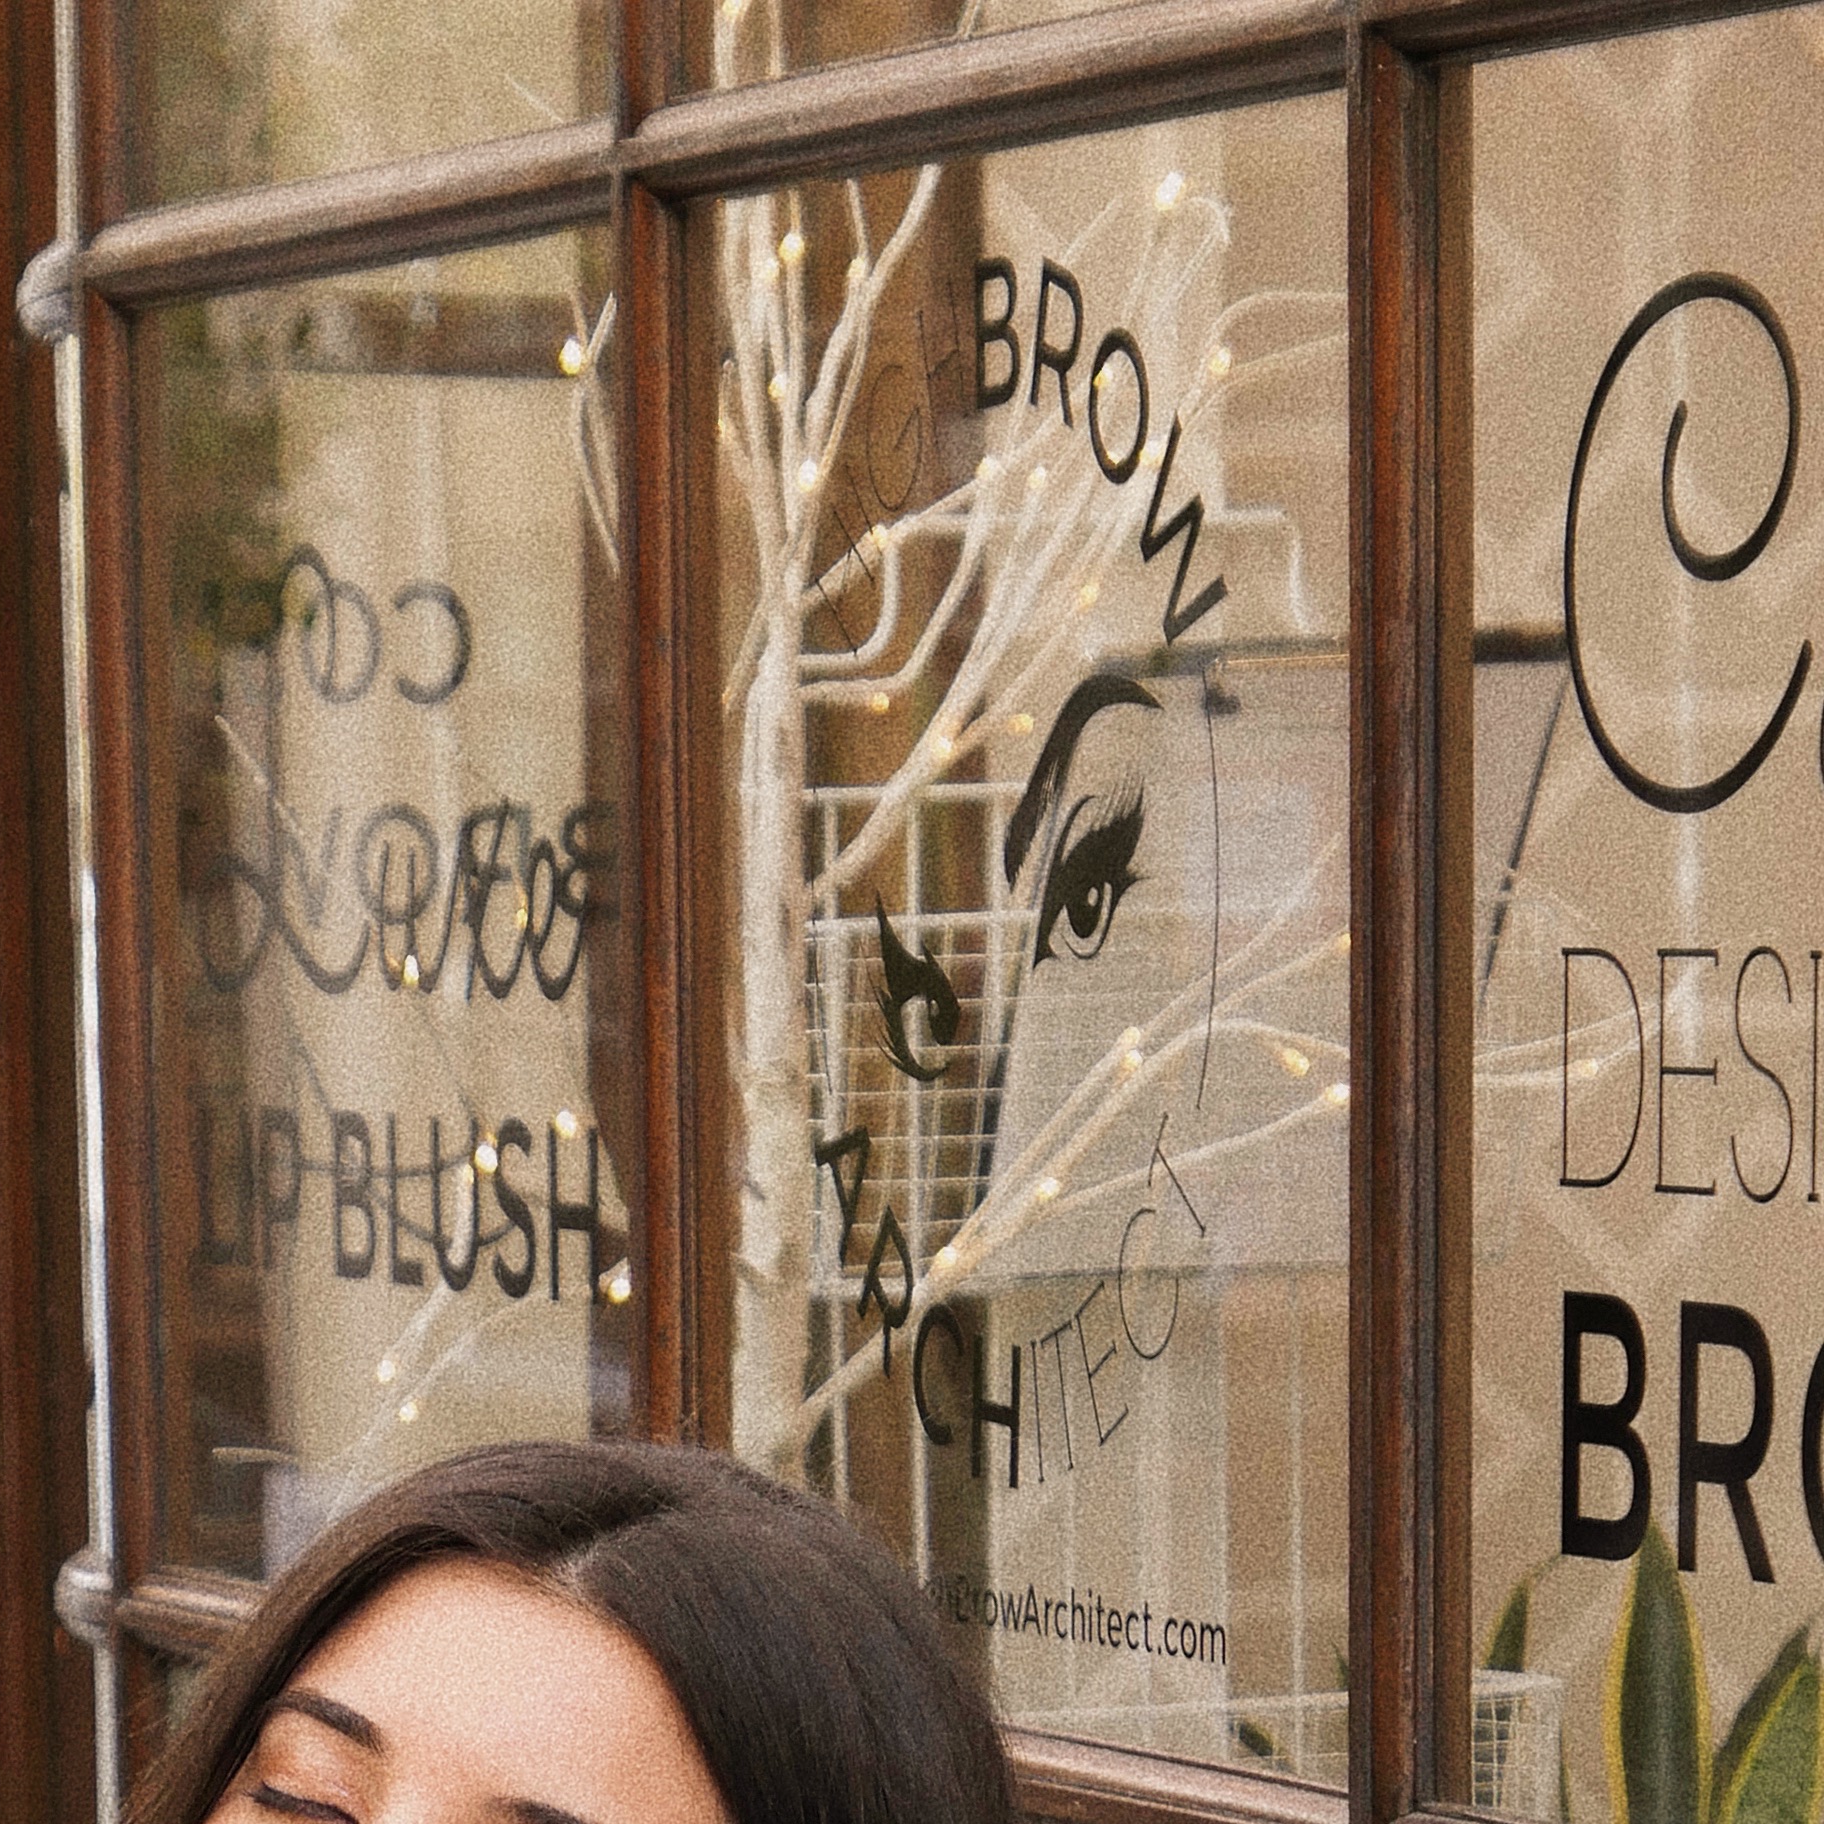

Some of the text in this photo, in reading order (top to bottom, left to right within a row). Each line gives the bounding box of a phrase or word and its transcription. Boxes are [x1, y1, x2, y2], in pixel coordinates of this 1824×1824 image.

[976, 256, 1228, 645] BROW
[333, 1109, 600, 1304] BLUSH
[814, 1111, 1207, 1489] ARCHITECT
[1560, 1290, 1824, 1584] BR
